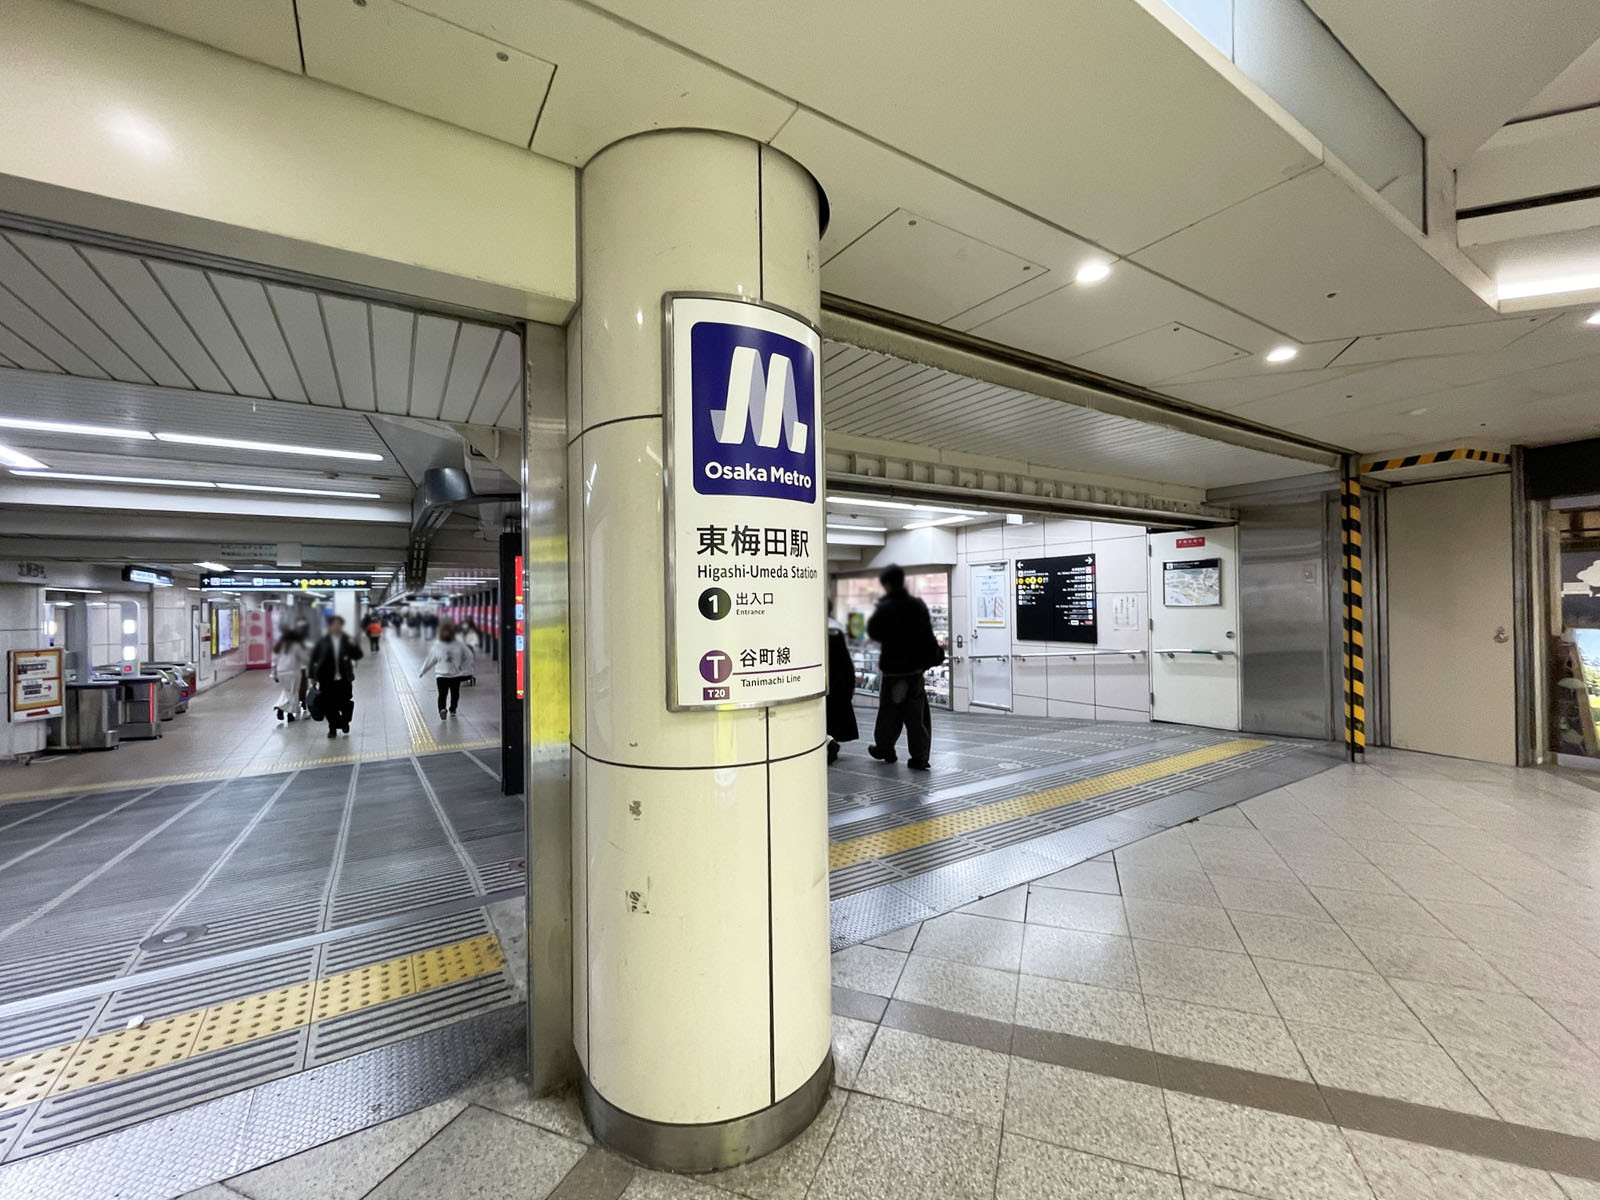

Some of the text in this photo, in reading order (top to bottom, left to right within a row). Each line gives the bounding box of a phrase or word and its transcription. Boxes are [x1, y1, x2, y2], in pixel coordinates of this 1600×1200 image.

[705, 461, 812, 488] Osaka Metro
[696, 524, 810, 558] 東梅田駅
[697, 564, 818, 582] Higashi-Umeda Station
[708, 594, 719, 614] 1
[736, 592, 774, 606] 出入口
[736, 608, 766, 616] Entrance
[739, 646, 791, 668] 谷町線
[706, 655, 726, 680] T
[741, 674, 802, 688] Tanimachi Line
[707, 689, 726, 698] T20
